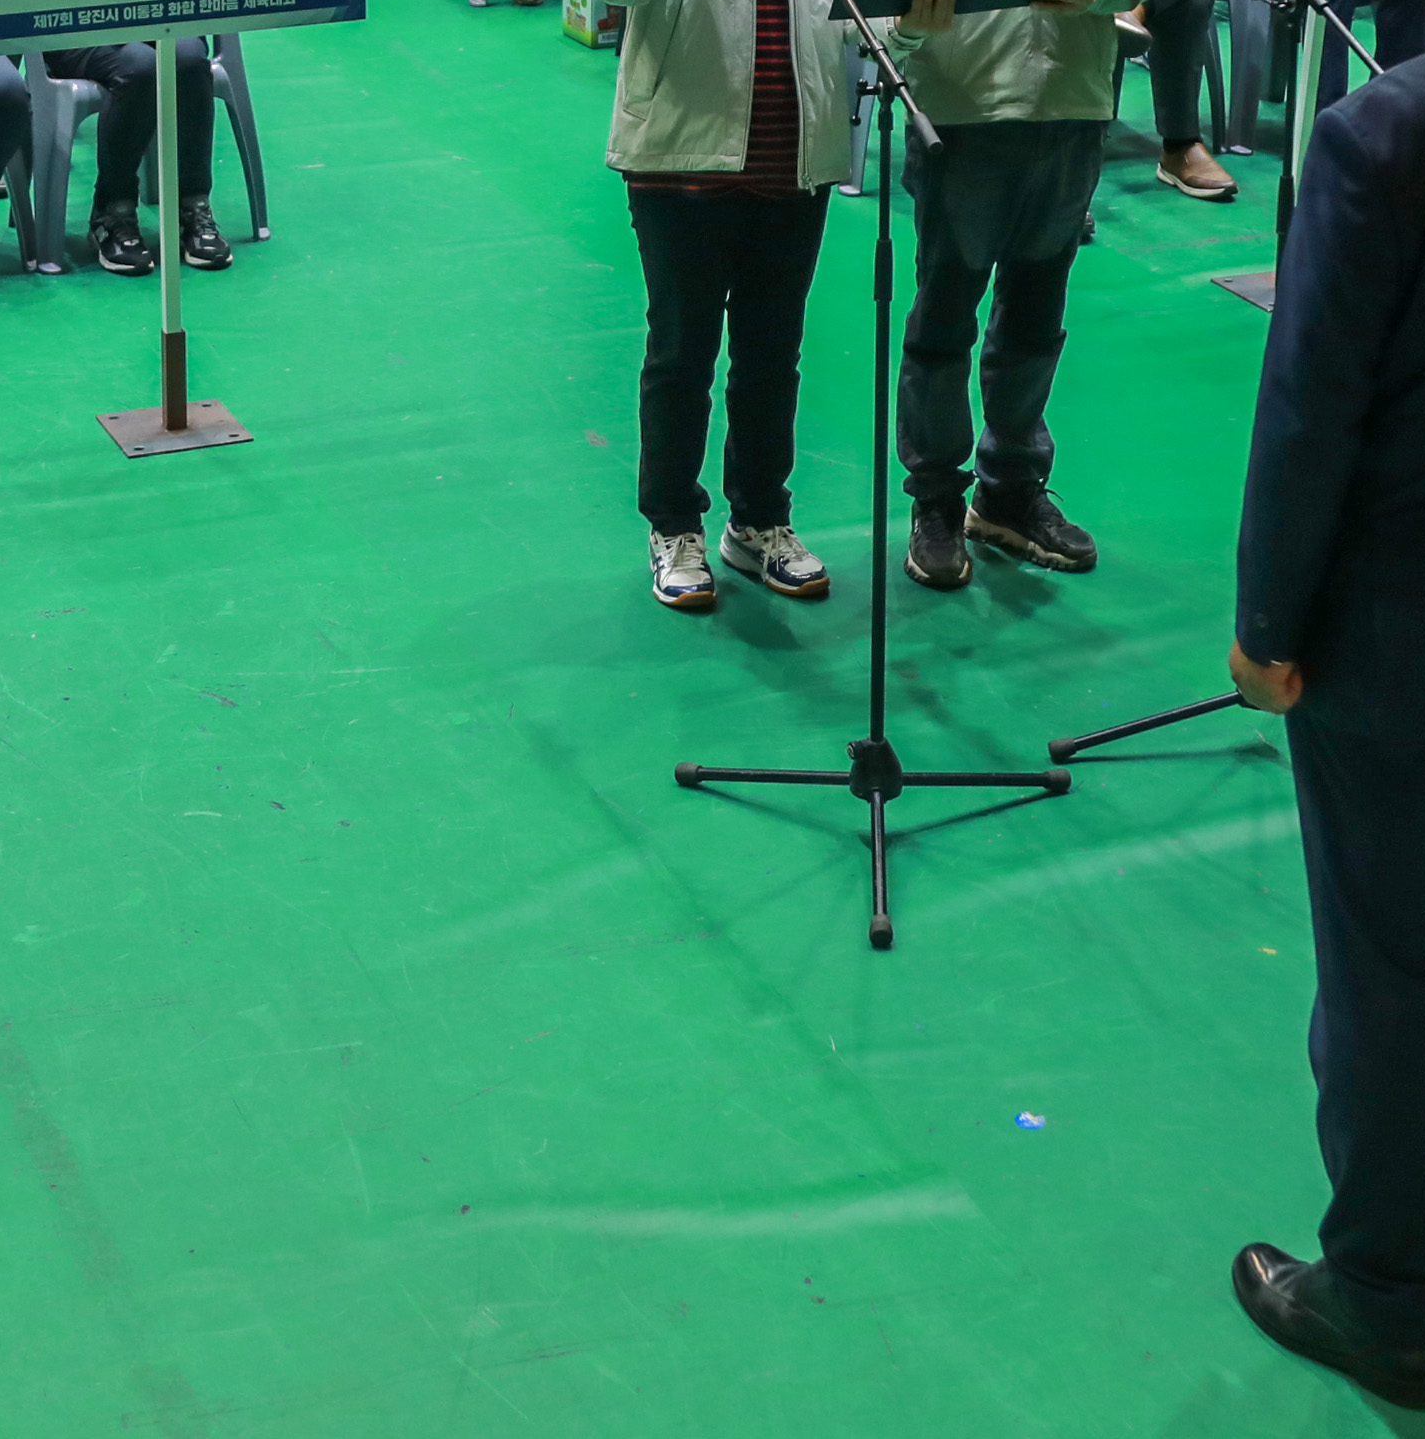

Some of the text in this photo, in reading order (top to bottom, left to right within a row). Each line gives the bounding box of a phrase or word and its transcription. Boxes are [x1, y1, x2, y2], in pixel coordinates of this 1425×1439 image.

[33, 12, 73, 29] 제17회
[77, 7, 119, 25] 당진시
[123, 3, 164, 21] 이통장
[168, 0, 195, 17] 화합
